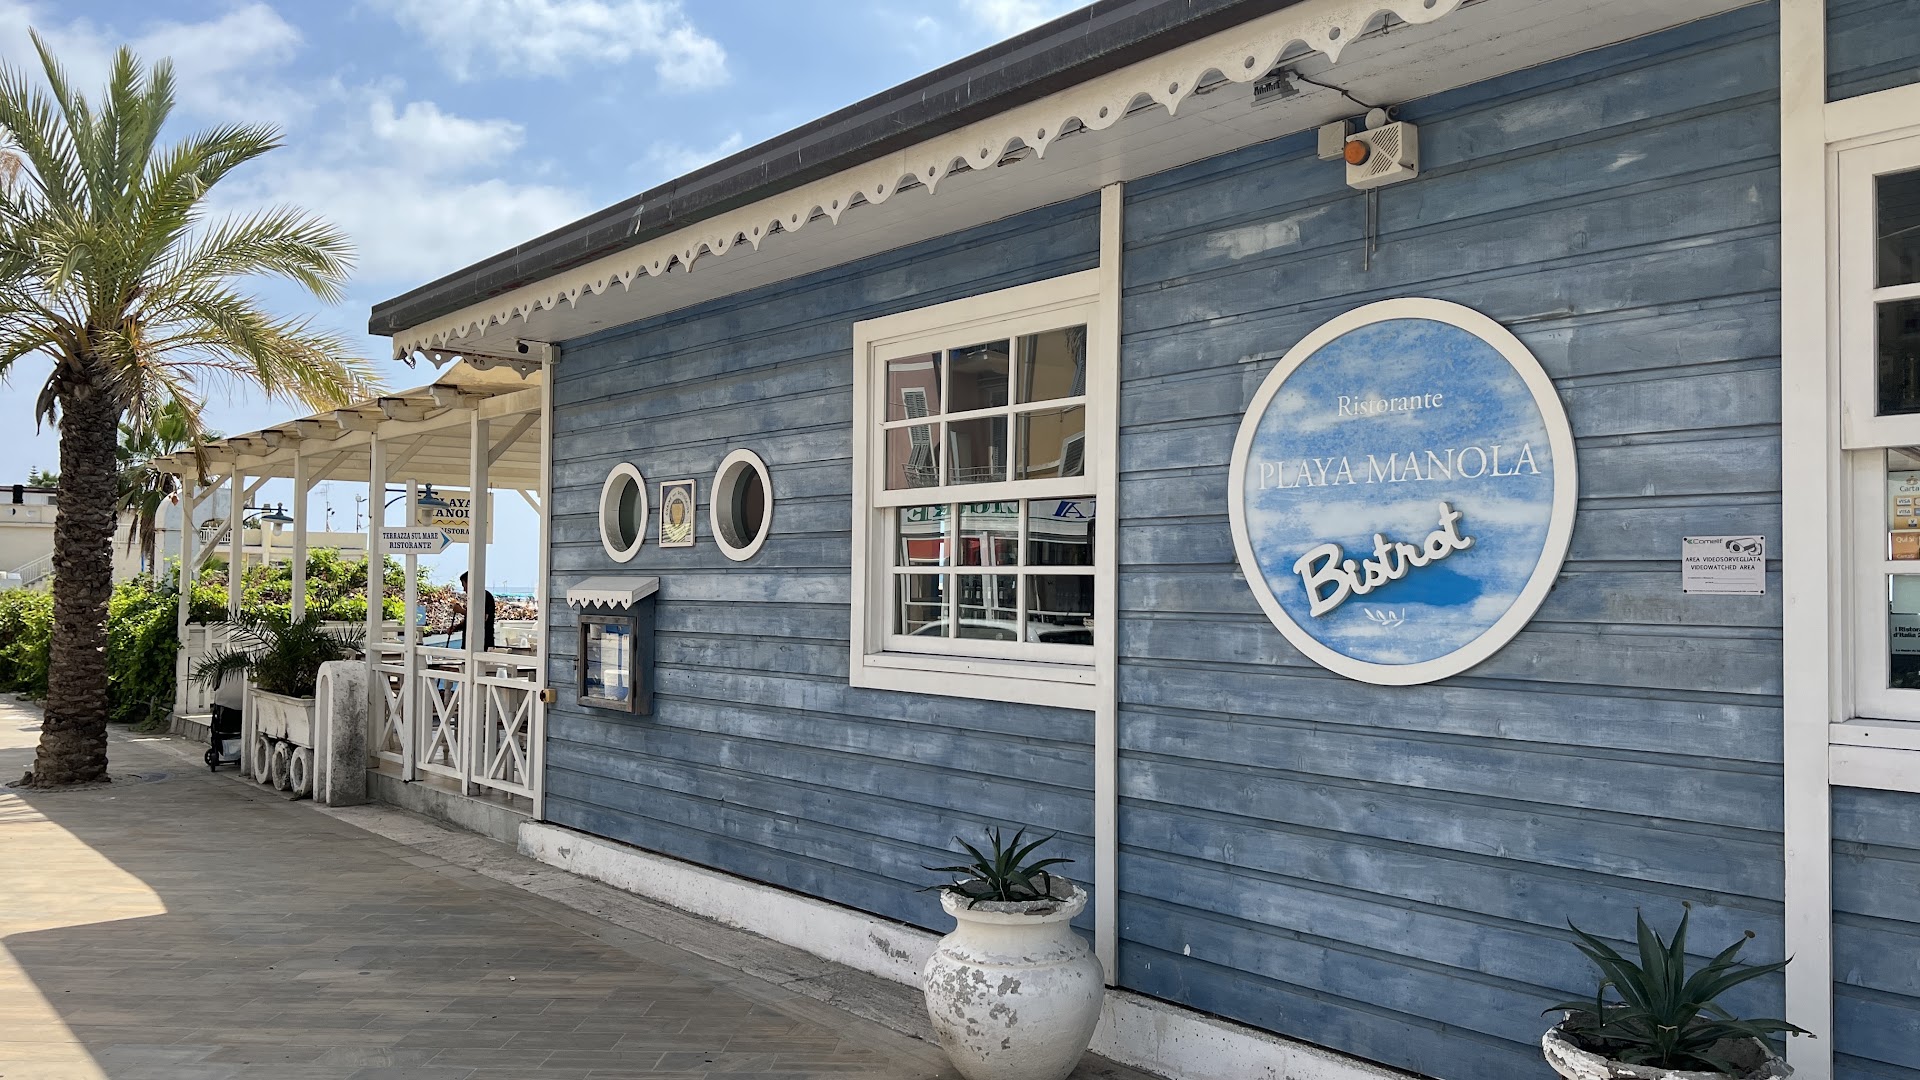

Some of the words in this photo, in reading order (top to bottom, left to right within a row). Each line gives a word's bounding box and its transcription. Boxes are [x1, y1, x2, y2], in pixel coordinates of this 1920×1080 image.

[1337, 392, 1443, 417] Ristorante
[1258, 455, 1357, 490] PLAYA
[1366, 443, 1542, 485] MANOLA
[1292, 501, 1476, 618] Bistrot
